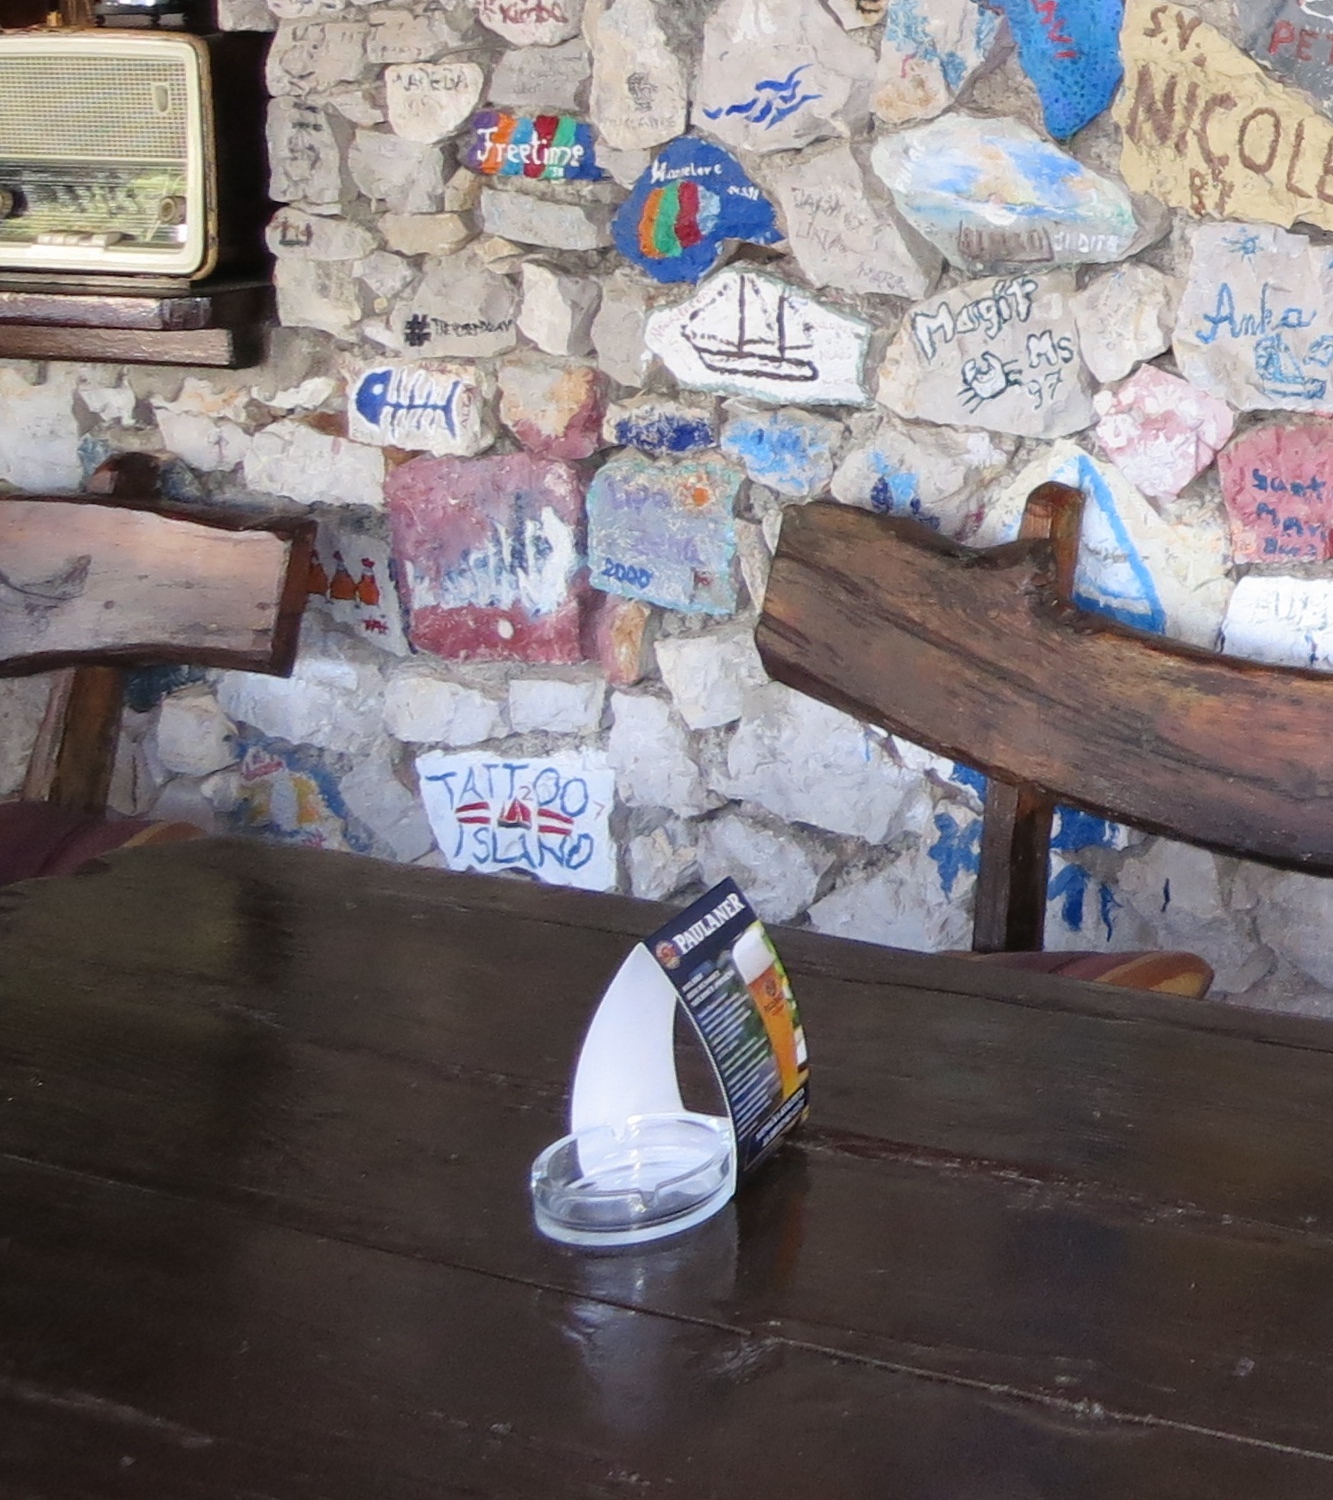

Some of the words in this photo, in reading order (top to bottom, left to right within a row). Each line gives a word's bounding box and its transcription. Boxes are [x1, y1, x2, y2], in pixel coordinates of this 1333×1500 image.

[425, 762, 592, 818] TATTOO
[454, 831, 595, 870] ISLAND
[671, 890, 748, 956] PAULANER
